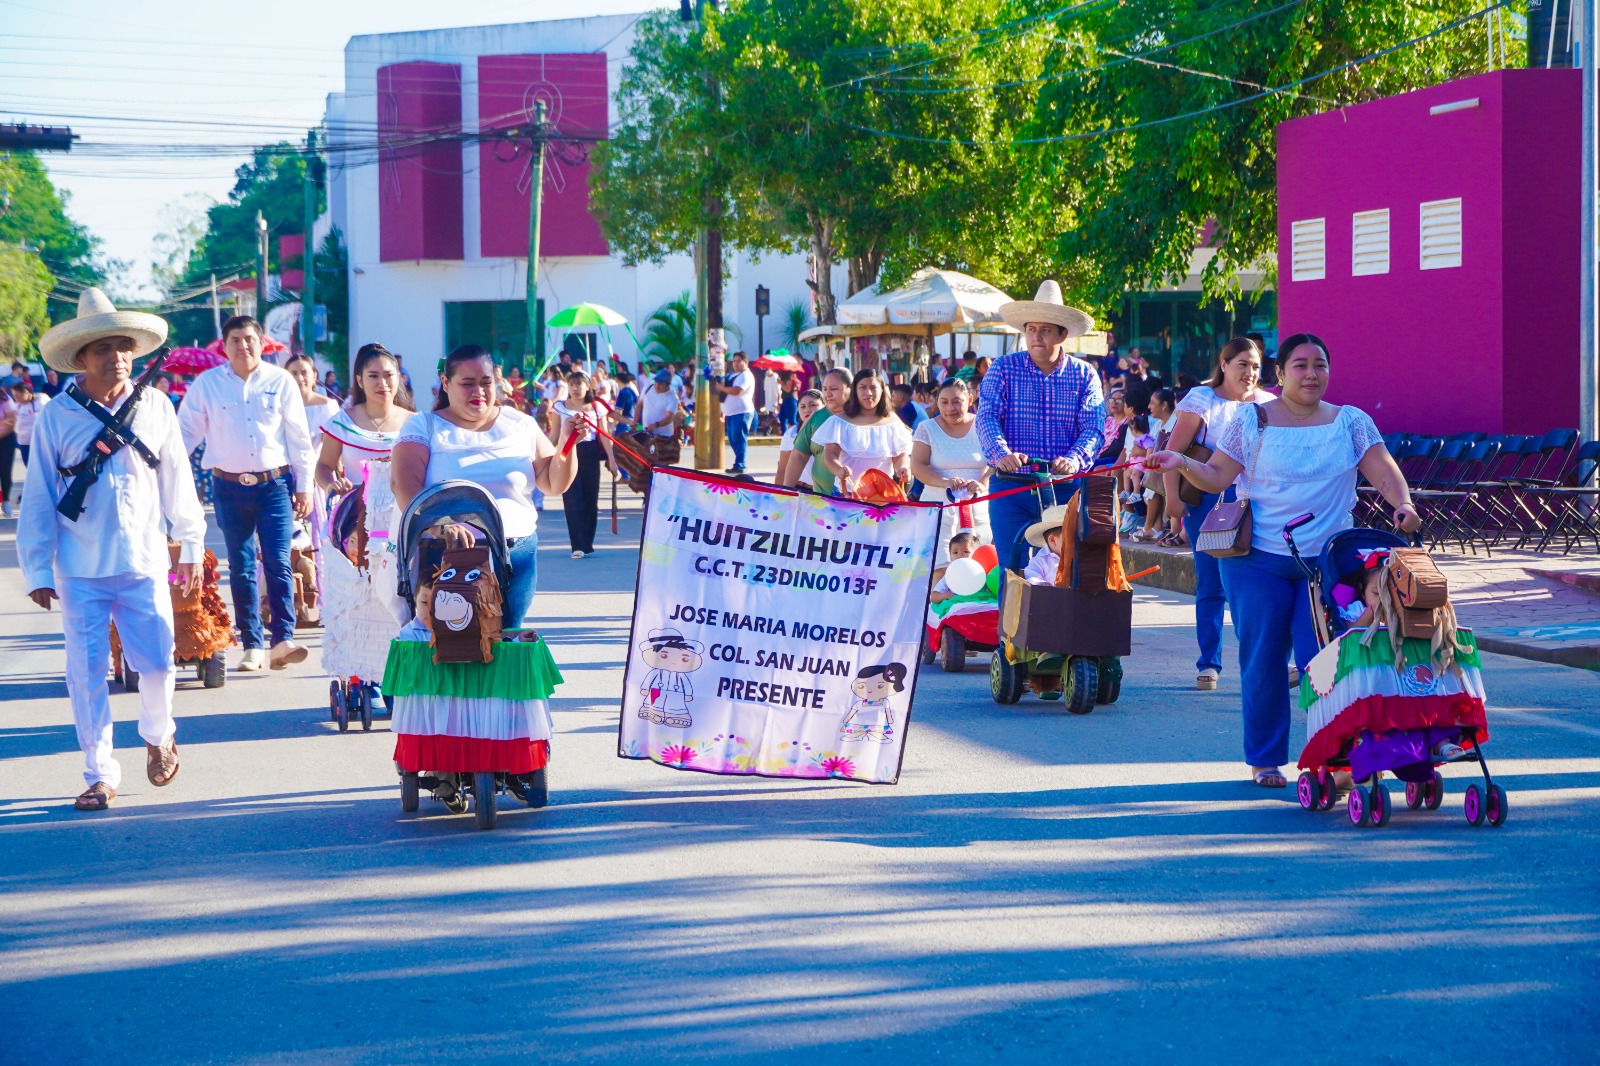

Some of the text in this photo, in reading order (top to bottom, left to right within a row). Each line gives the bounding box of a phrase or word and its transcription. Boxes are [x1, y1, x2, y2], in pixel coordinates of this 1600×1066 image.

[667, 515, 910, 569] "HUITZILIHUITL"
[695, 556, 877, 595] C.C.T. 23DIN0013F
[670, 605, 886, 647] JOSE MARIA MORELOS
[710, 644, 850, 676] COL. SAN JUAN
[717, 677, 825, 708] PRESENTE
